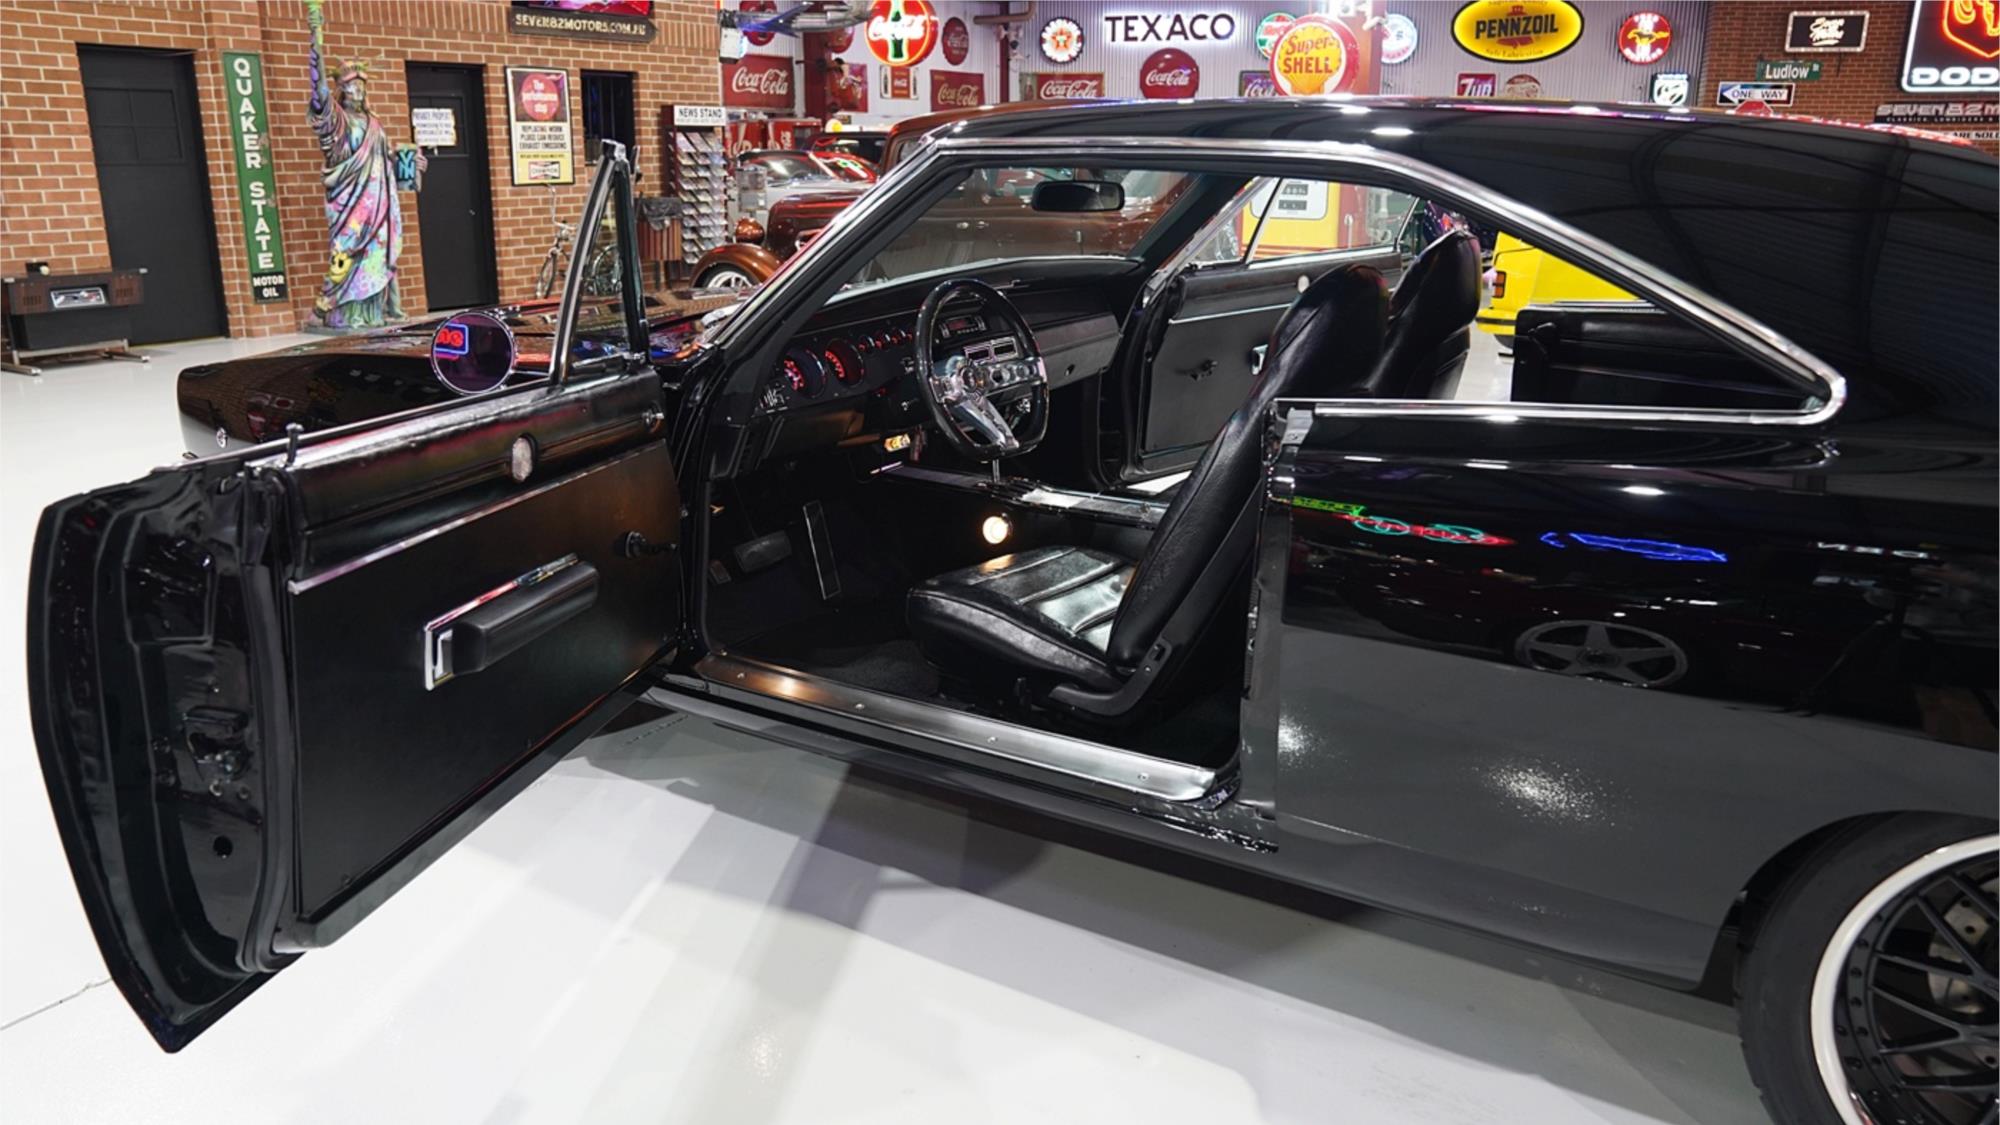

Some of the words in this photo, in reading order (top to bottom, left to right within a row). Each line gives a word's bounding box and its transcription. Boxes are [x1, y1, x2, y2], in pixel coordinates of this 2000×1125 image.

[1104, 13, 1236, 42] TEXACO
[1475, 14, 1559, 39] PENNZOIL
[1283, 56, 1333, 74] SHELL
[1765, 63, 1810, 79] Ludlow
[1731, 89, 1753, 99] ONE
[1761, 89, 1785, 99] WAY
[679, 108, 698, 118] NEWS
[700, 108, 722, 118] STAND
[233, 57, 261, 169] QUAKER
[249, 181, 275, 269] STATE
[252, 275, 285, 287] MOTOR
[262, 287, 279, 298] OIL
